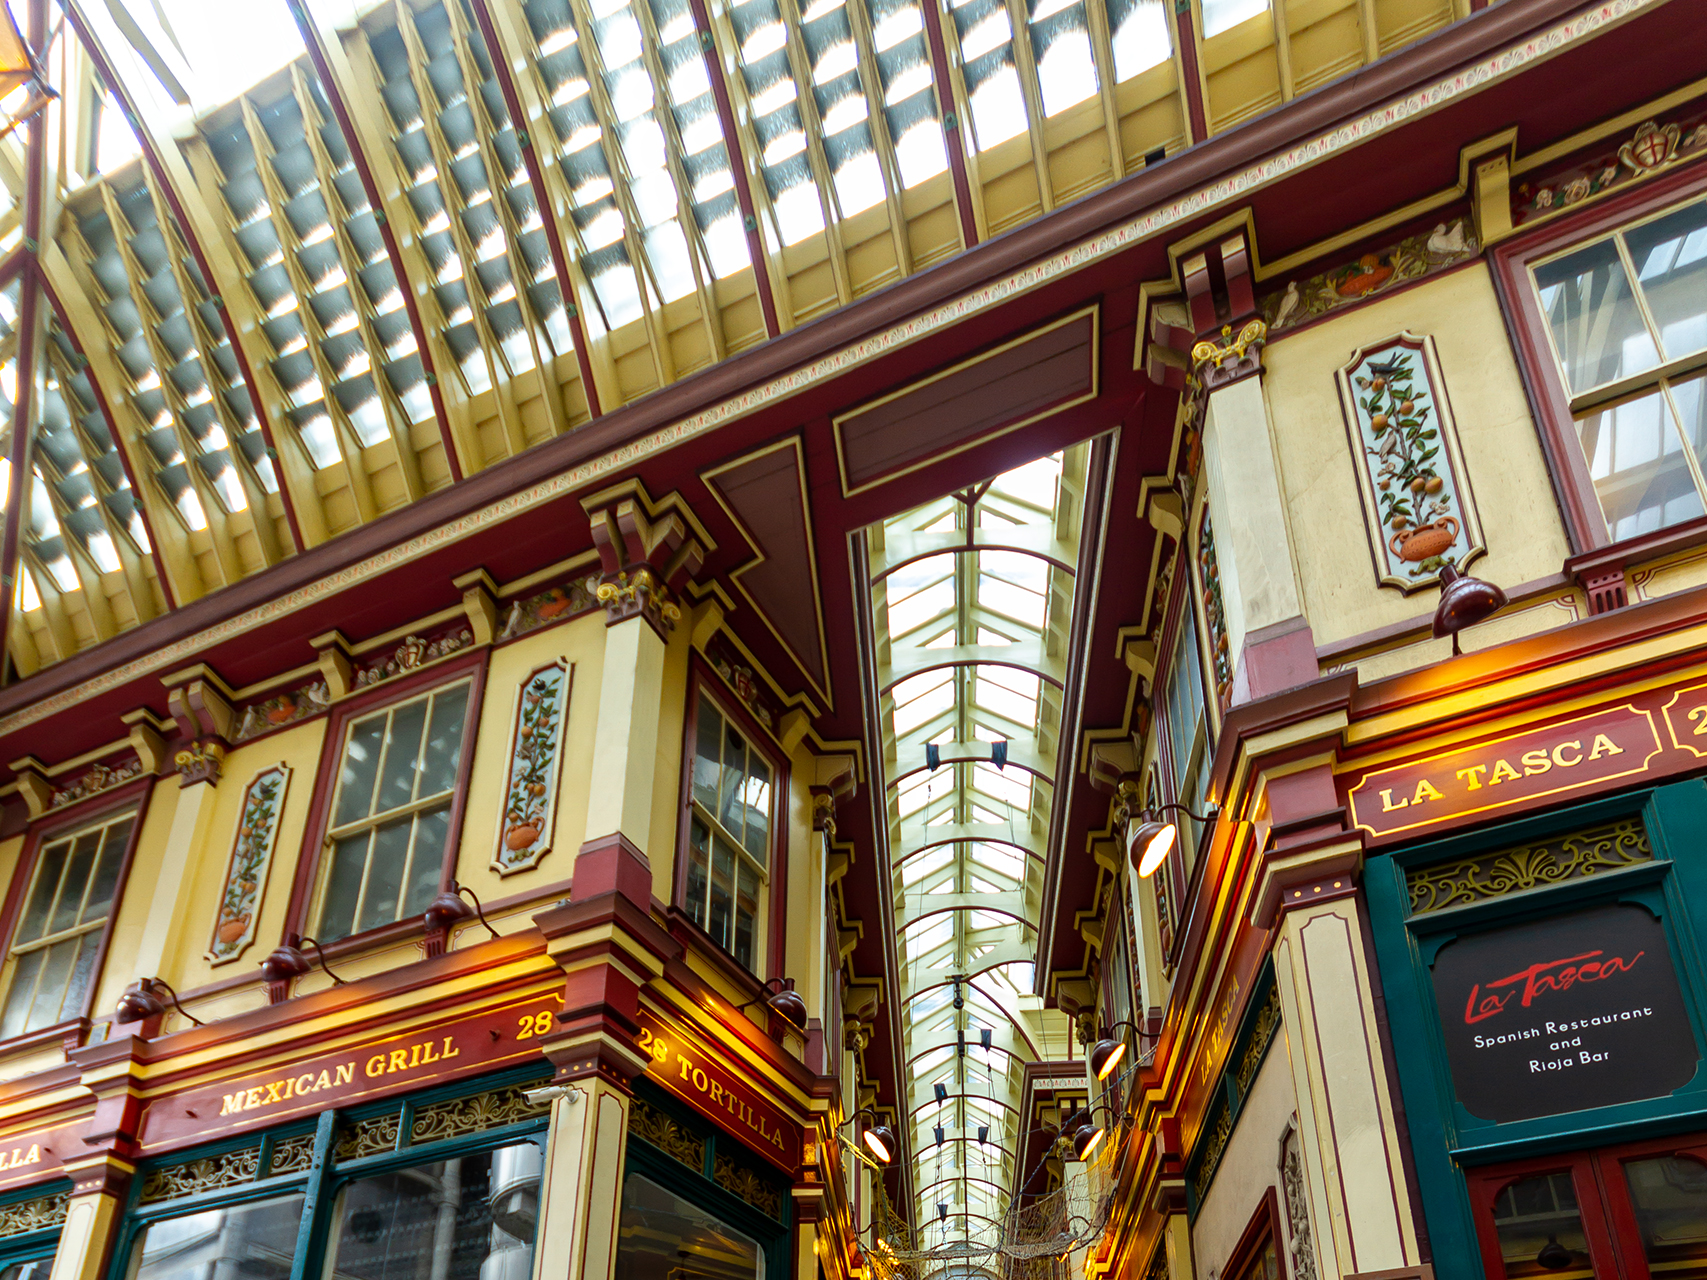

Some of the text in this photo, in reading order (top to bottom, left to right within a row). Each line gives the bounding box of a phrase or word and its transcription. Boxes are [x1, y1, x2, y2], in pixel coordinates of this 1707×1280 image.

[1379, 733, 1624, 813] LA TASCA
[1465, 950, 1645, 1025] La Tasca
[516, 1010, 553, 1041] 28
[1201, 973, 1240, 1086] LA TASCA
[1474, 1007, 1653, 1049] Spanish Restaurant
[1529, 1050, 1609, 1074] Rioja Bar
[1550, 1036, 1582, 1051] and
[219, 1036, 460, 1117] MEXICAN GRILL
[638, 1027, 785, 1152] 28 TORTILLA
